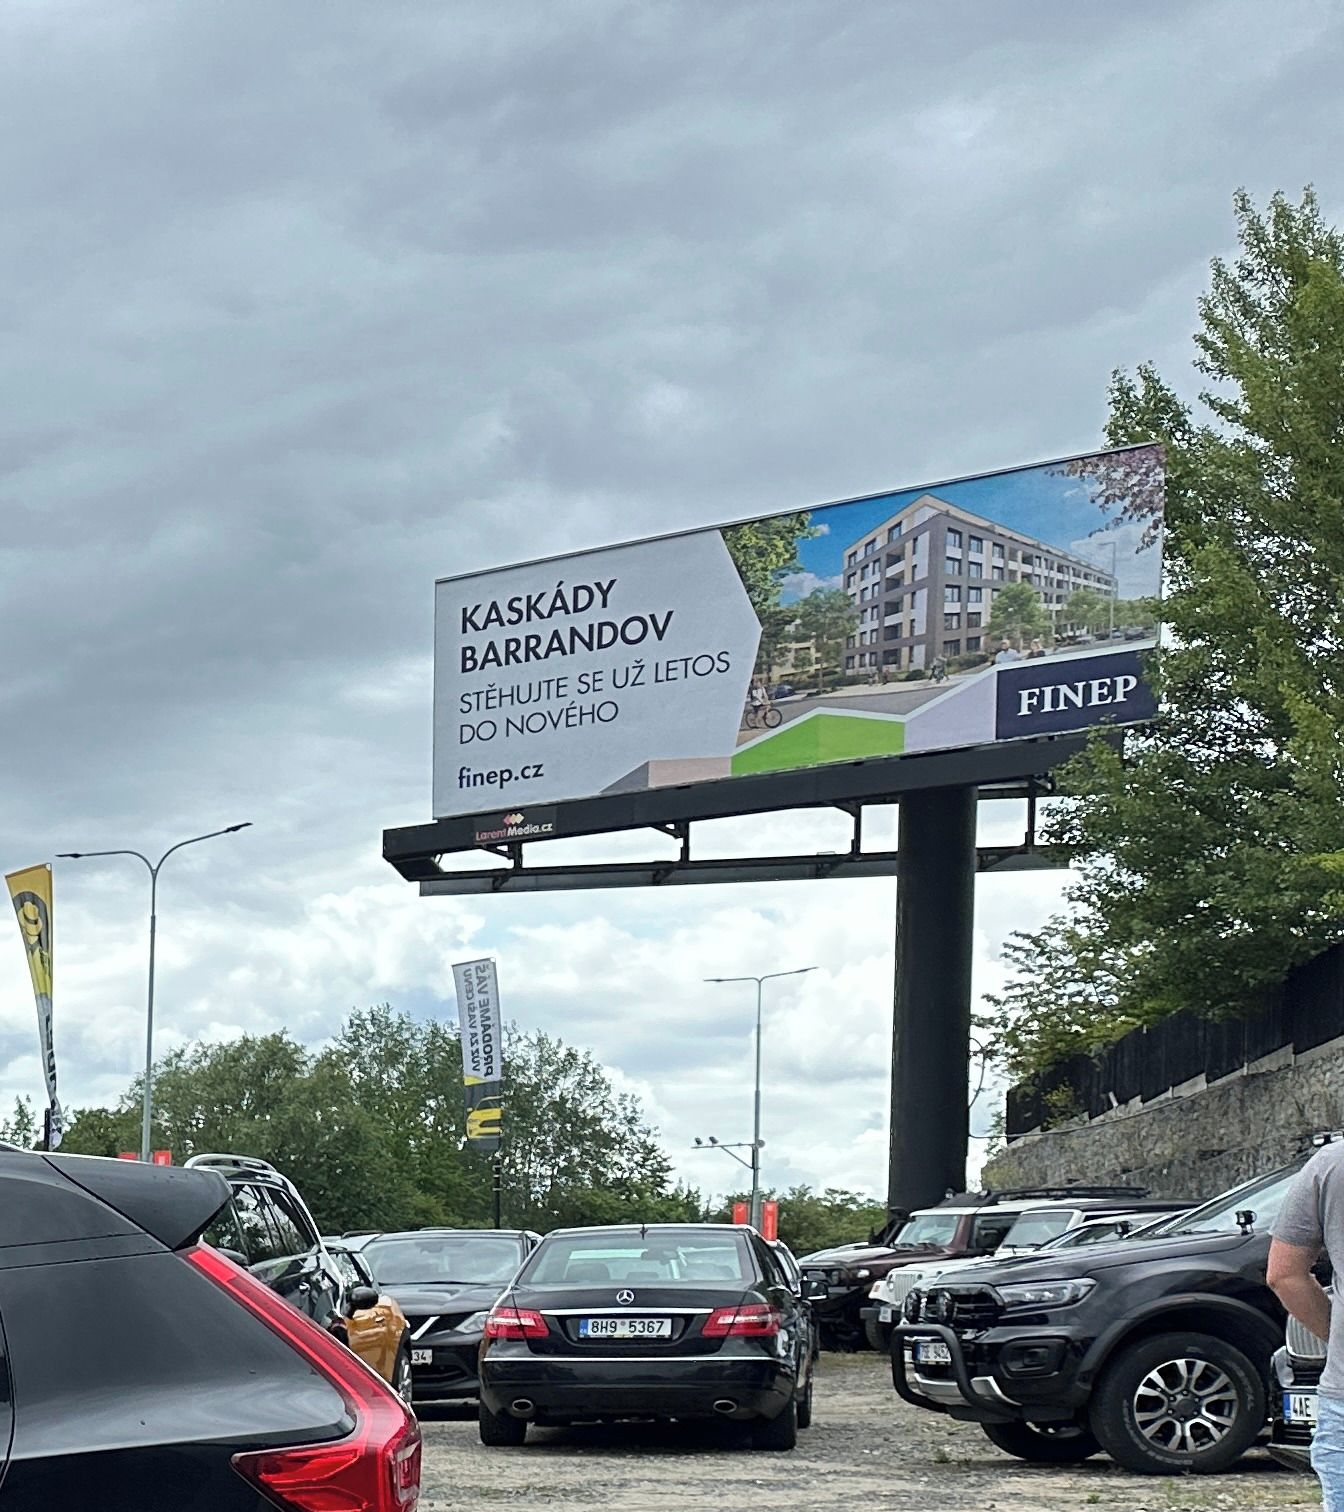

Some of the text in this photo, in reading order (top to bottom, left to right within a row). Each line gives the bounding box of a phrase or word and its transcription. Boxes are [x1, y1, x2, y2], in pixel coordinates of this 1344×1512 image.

[461, 579, 617, 634] KASKÁDY
[461, 610, 674, 674] BARRANDOV
[459, 651, 730, 714] STĚHUJTE SE UŽ LETOS
[1016, 674, 1138, 716] FINEP
[459, 700, 619, 745] DO NOVÉHO
[457, 763, 544, 790] finep.cz
[591, 1320, 665, 1333] 8H9 5367
